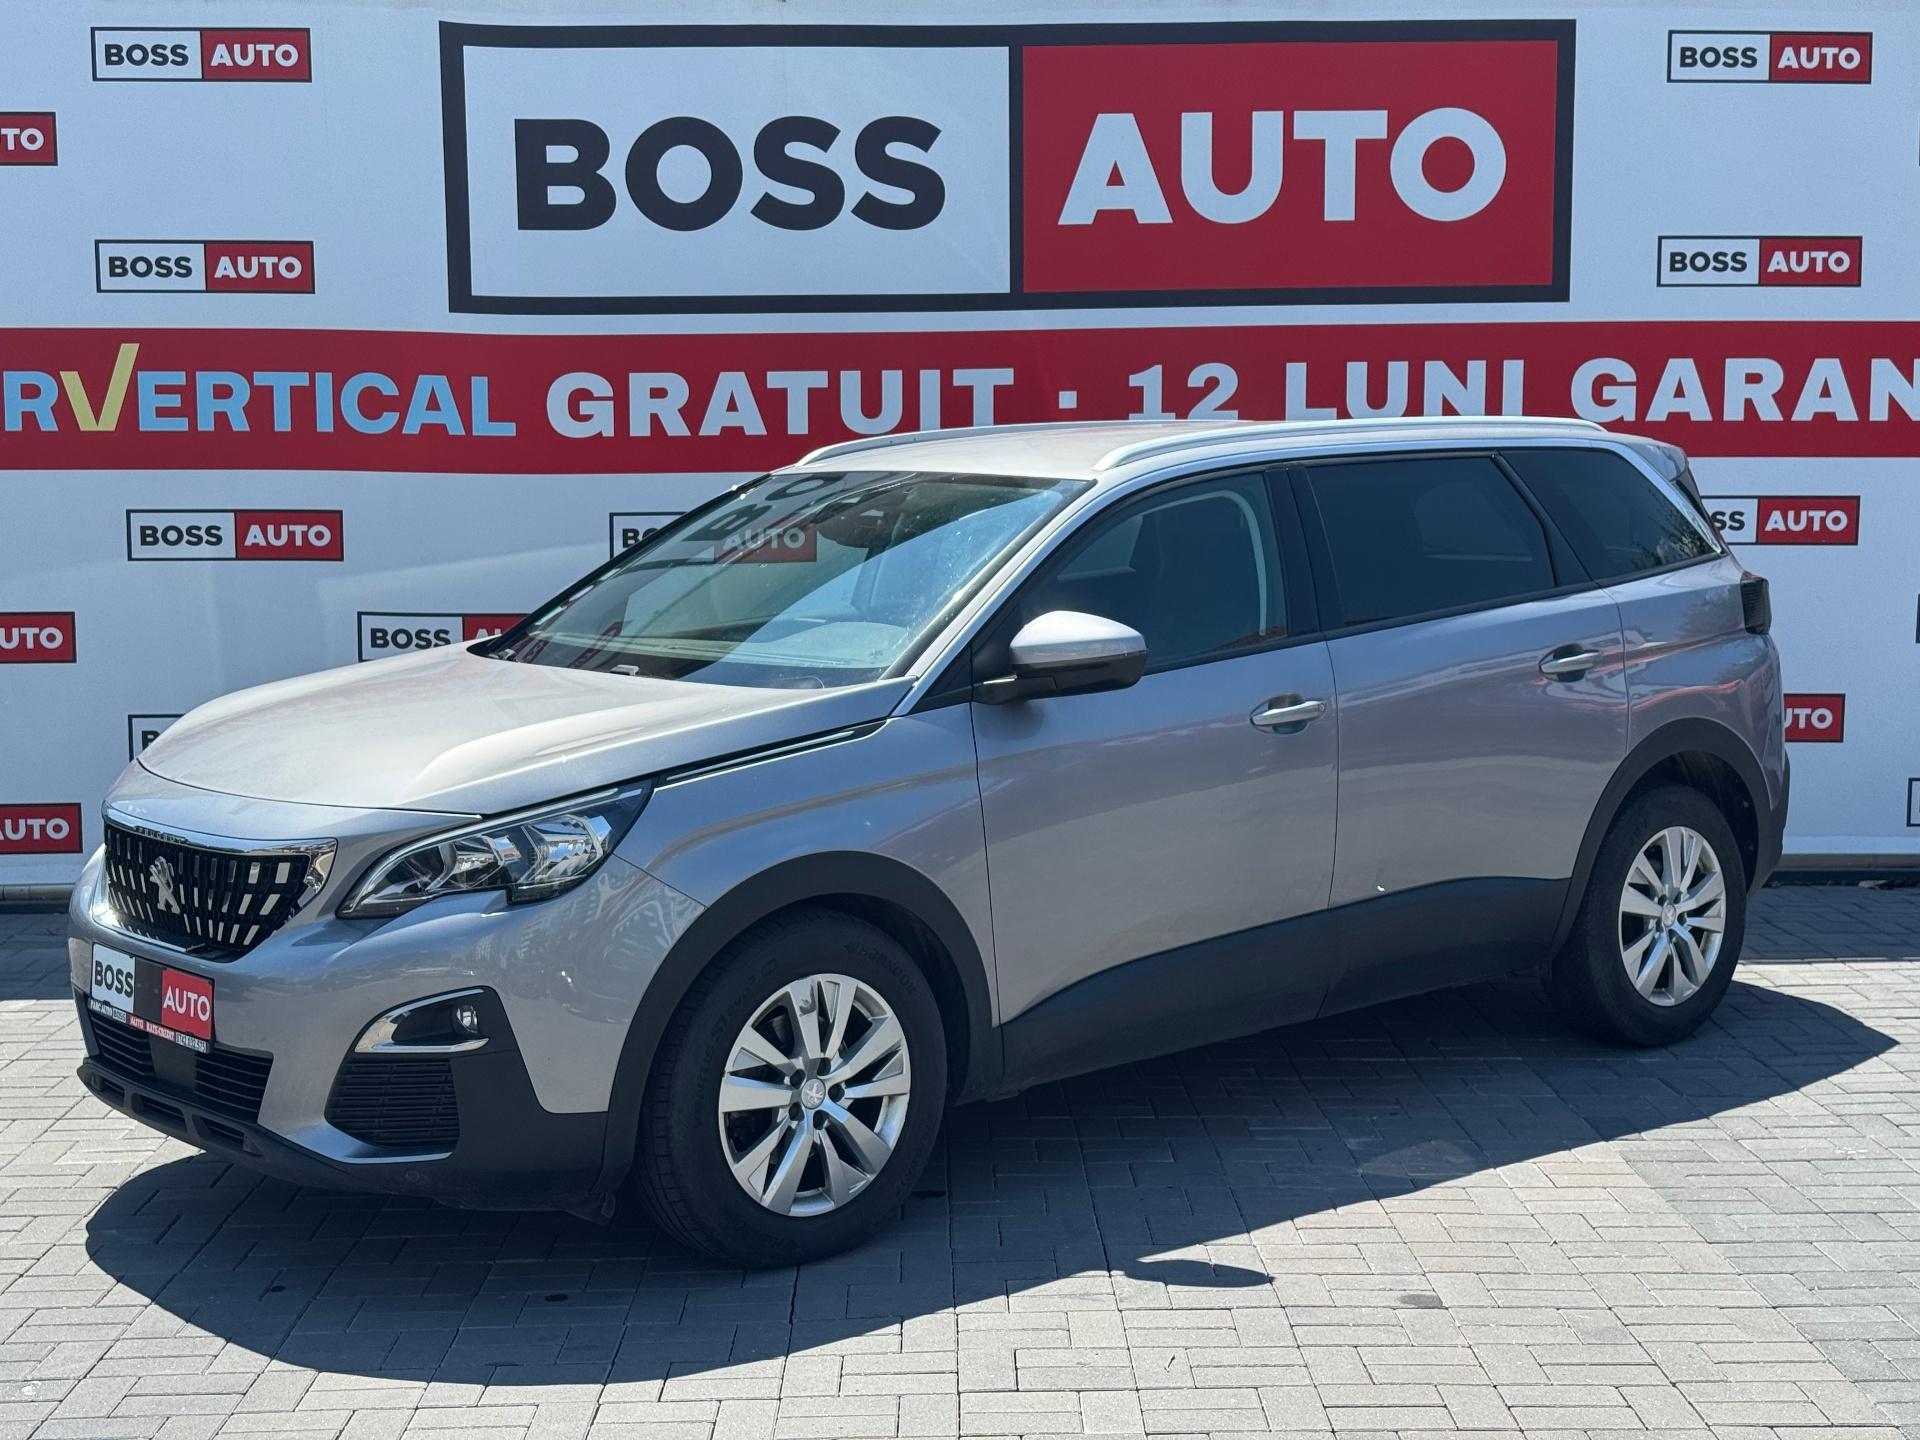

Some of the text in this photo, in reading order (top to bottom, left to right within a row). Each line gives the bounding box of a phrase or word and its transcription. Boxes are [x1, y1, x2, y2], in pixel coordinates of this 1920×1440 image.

[105, 44, 298, 66] BOSS AUTO
[1680, 47, 1860, 69] BOSS AUTO
[515, 108, 1506, 231] BOSS AUTO
[109, 256, 301, 278] BOSS AUTO
[1670, 251, 1850, 272] BOSS AUTO
[546, 367, 1014, 438] GRATUIT
[1129, 363, 1238, 420] 12
[1286, 360, 1524, 420] LUNI
[1571, 357, 1920, 422] GARAN
[1765, 511, 1847, 531] AUTO
[140, 525, 331, 546] BOSS AUTO
[0, 627, 63, 649] UTO
[371, 628, 451, 648] BOSS
[0, 818, 69, 840] UTO
[94, 960, 210, 1021] BOSS AUTO
